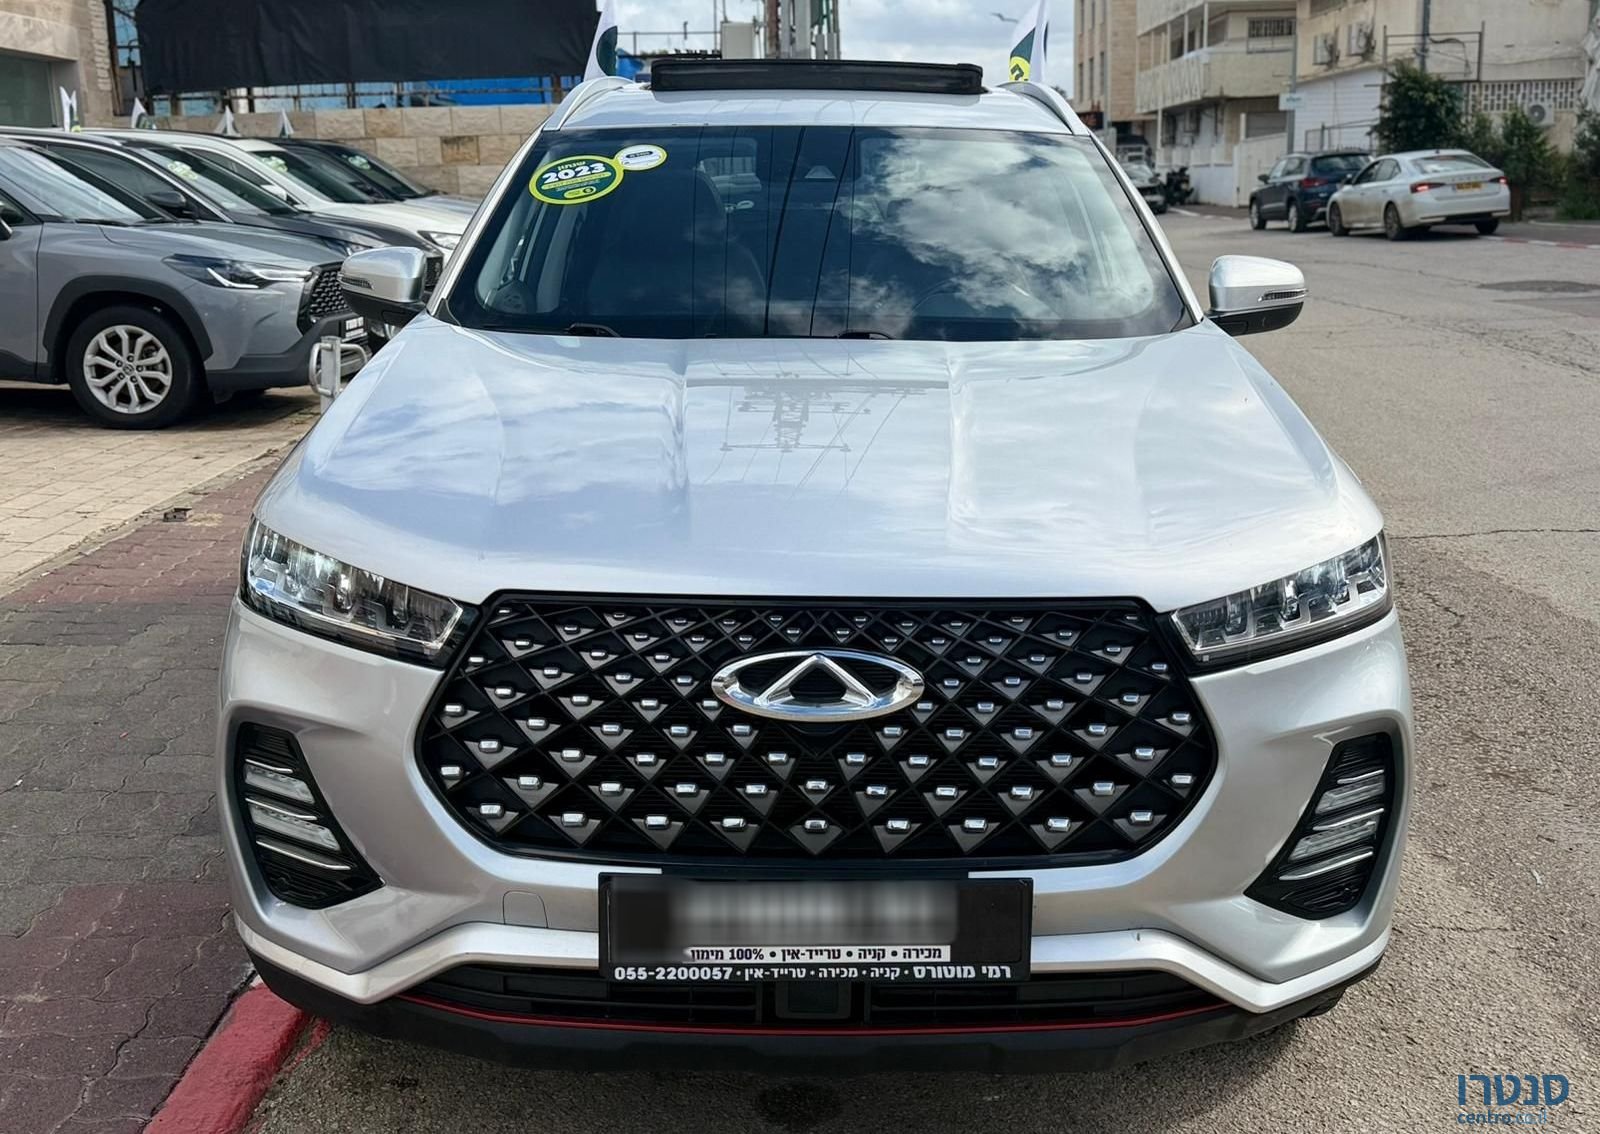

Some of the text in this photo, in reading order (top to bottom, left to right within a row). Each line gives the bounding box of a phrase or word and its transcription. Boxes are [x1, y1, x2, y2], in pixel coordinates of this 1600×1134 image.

[542, 163, 606, 184] 2023
[729, 948, 764, 961] 100%
[782, 948, 841, 962] טרייד-אין
[858, 947, 886, 961] קניה
[903, 947, 942, 960] מכירה
[614, 965, 1011, 981] רמי מוטורס קניה מכירה טרייד-אין 055-2200057
